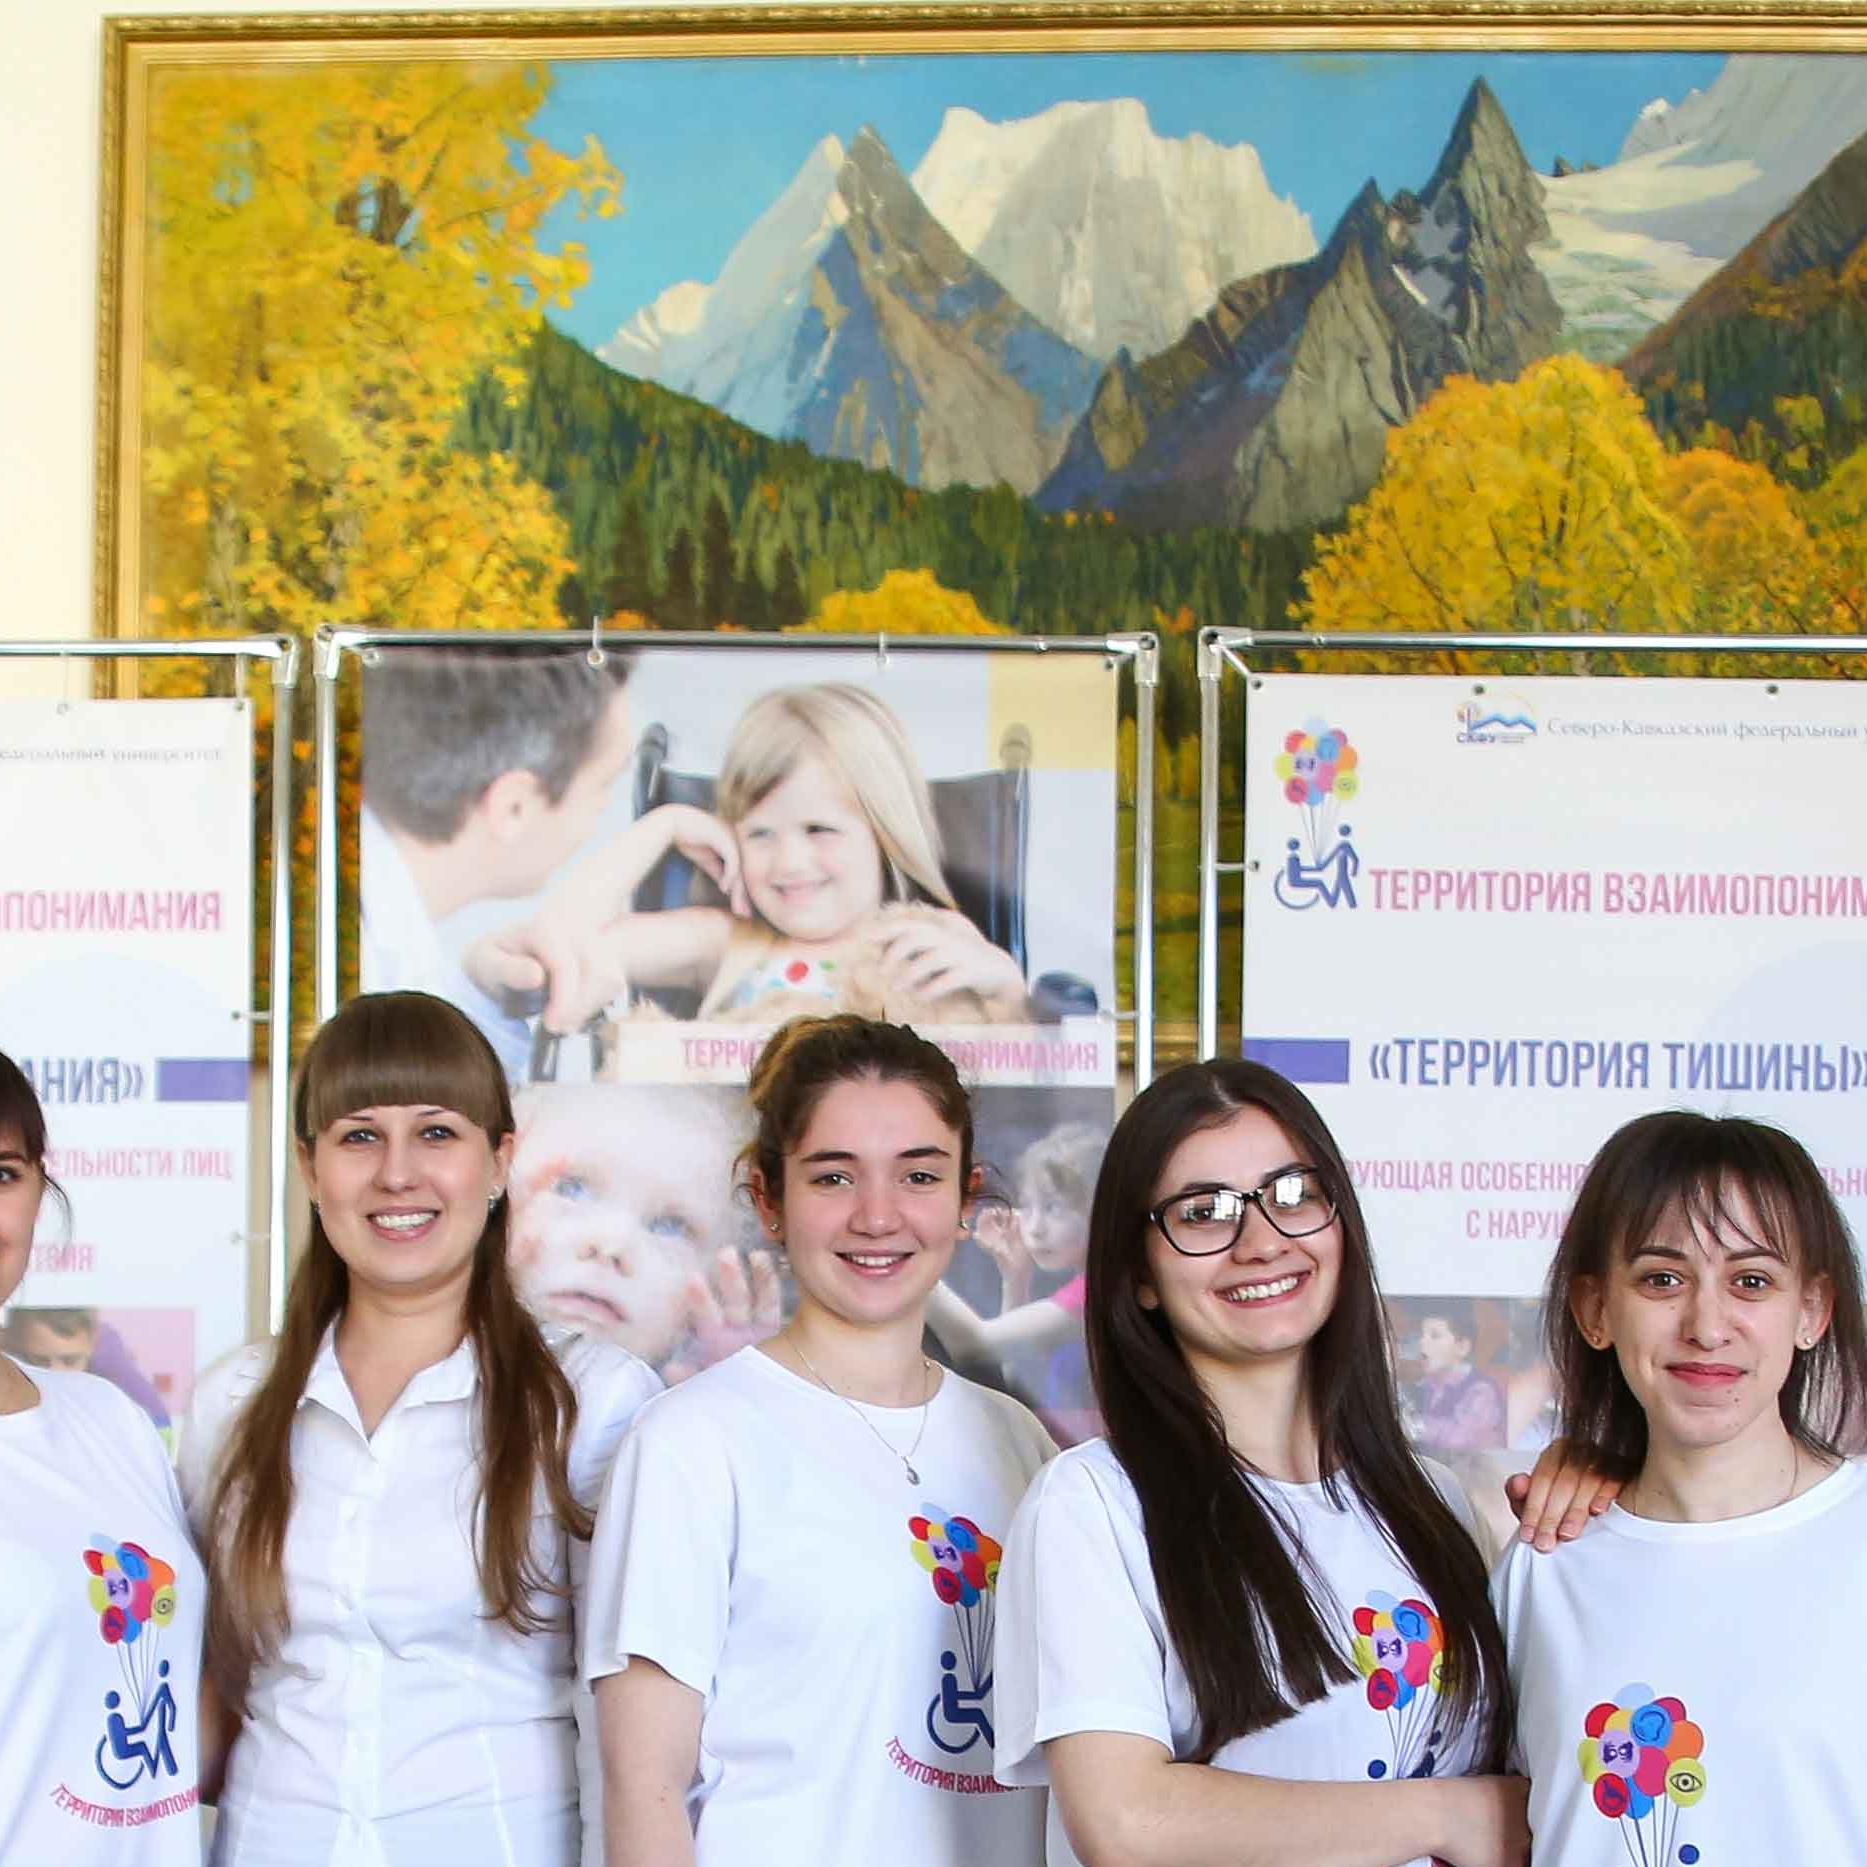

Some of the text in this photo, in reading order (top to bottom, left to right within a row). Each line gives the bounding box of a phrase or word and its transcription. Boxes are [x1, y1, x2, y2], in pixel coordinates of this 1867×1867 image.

[1368, 868, 1592, 914] ТЕРРИТОРИЯ
[1368, 1038, 1650, 1091] «ТЕРРИТОРИЯ
[1465, 1209, 1481, 1240] С
